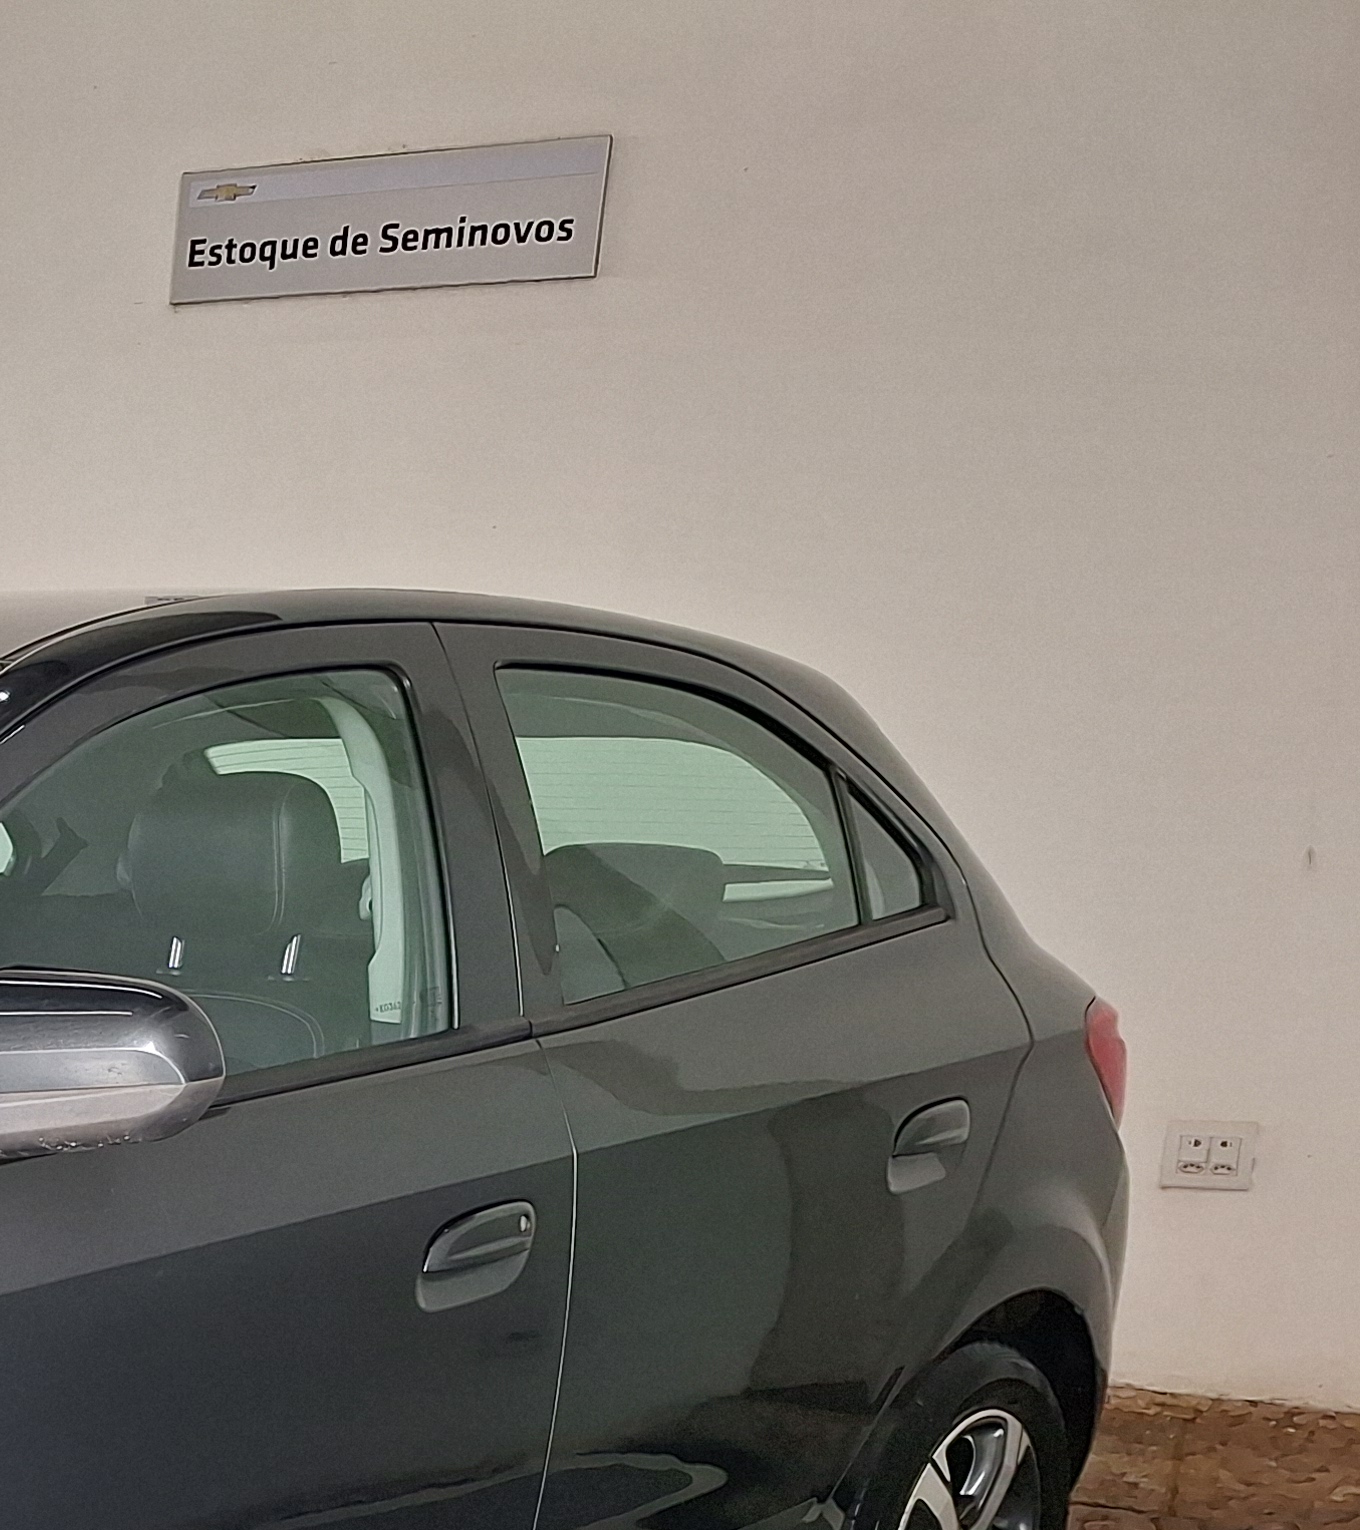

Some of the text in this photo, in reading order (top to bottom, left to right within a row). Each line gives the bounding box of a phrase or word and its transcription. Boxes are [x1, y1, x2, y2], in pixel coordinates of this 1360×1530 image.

[187, 216, 575, 270] Estoque de Seminovos
